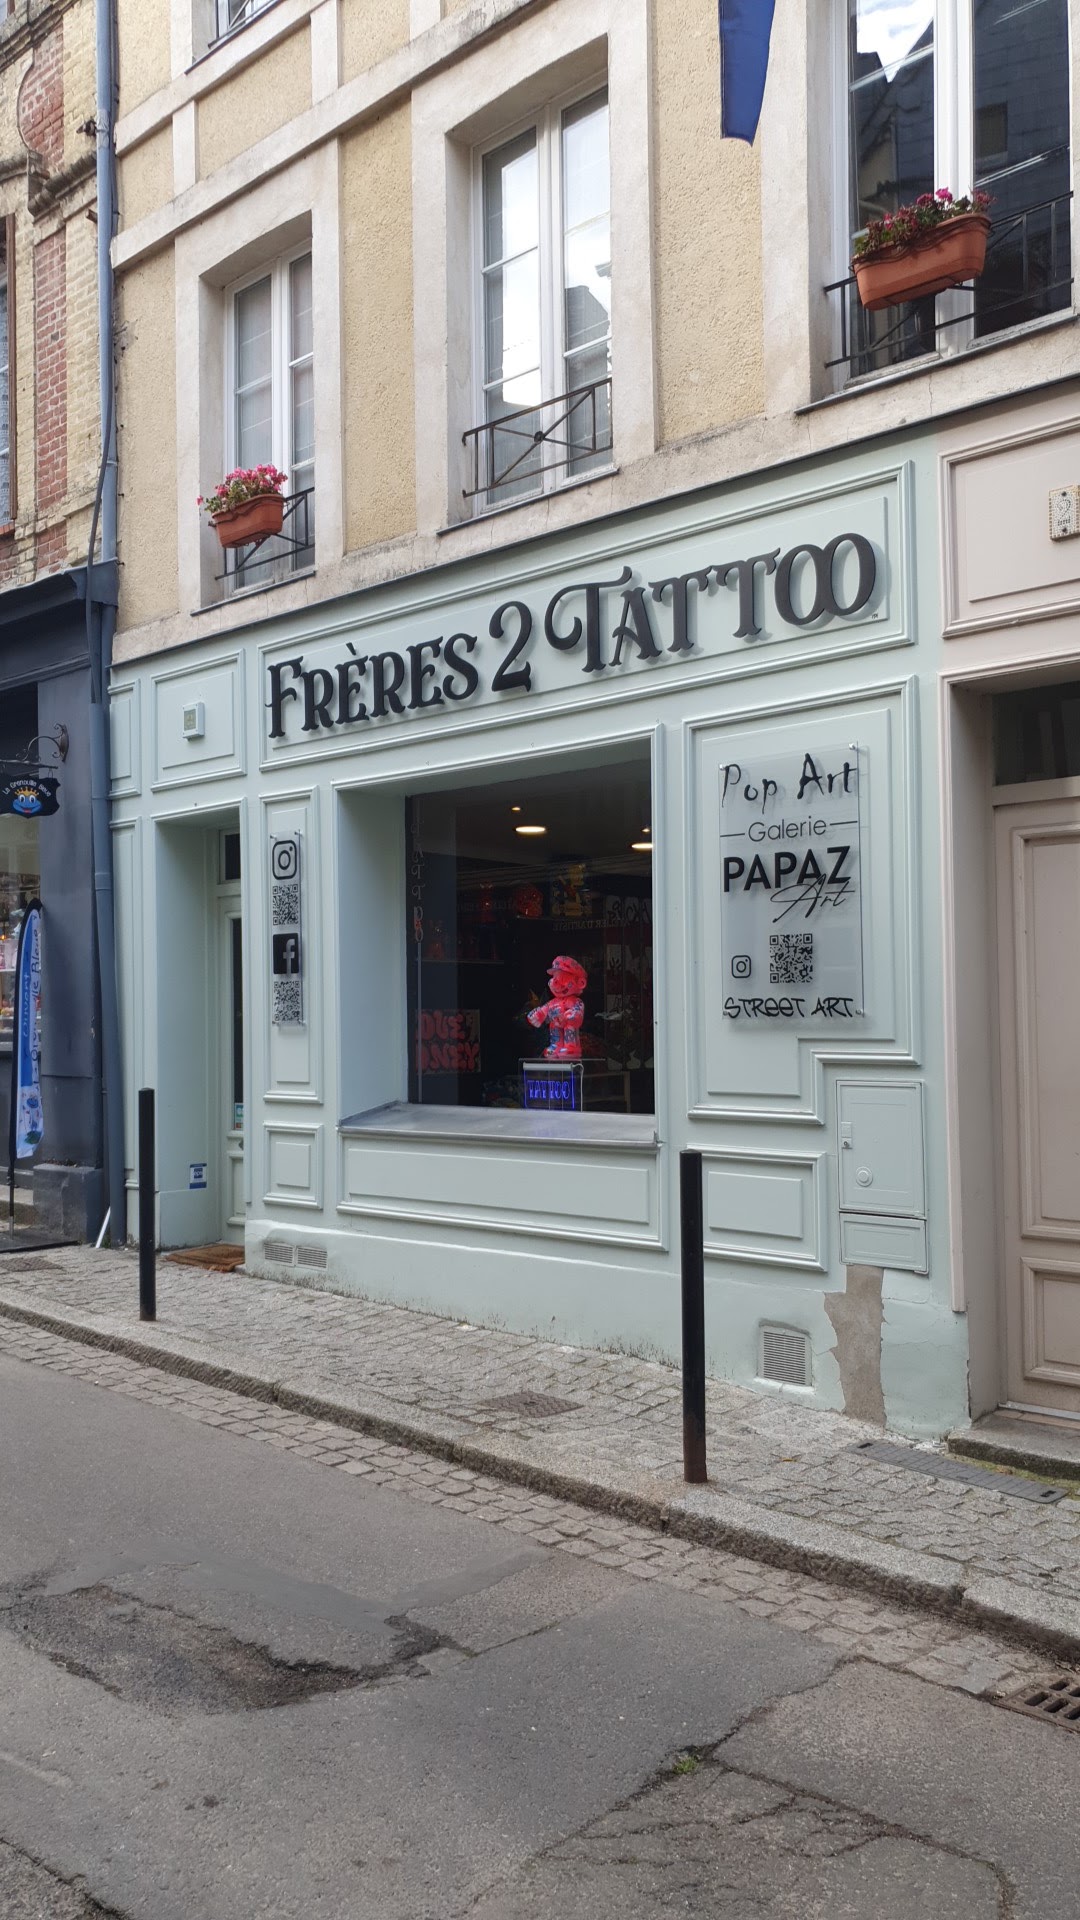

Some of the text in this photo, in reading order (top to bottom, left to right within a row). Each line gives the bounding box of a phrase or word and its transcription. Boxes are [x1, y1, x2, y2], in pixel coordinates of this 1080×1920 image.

[265, 532, 877, 739] FRÈRES 2 TATTOO
[721, 753, 857, 814] Pop Art
[748, 815, 827, 842] Galerie
[723, 845, 851, 893] PAPAZ
[770, 873, 856, 923] Art
[811, 997, 854, 1017] ART
[527, 1080, 570, 1099] TATTOO
